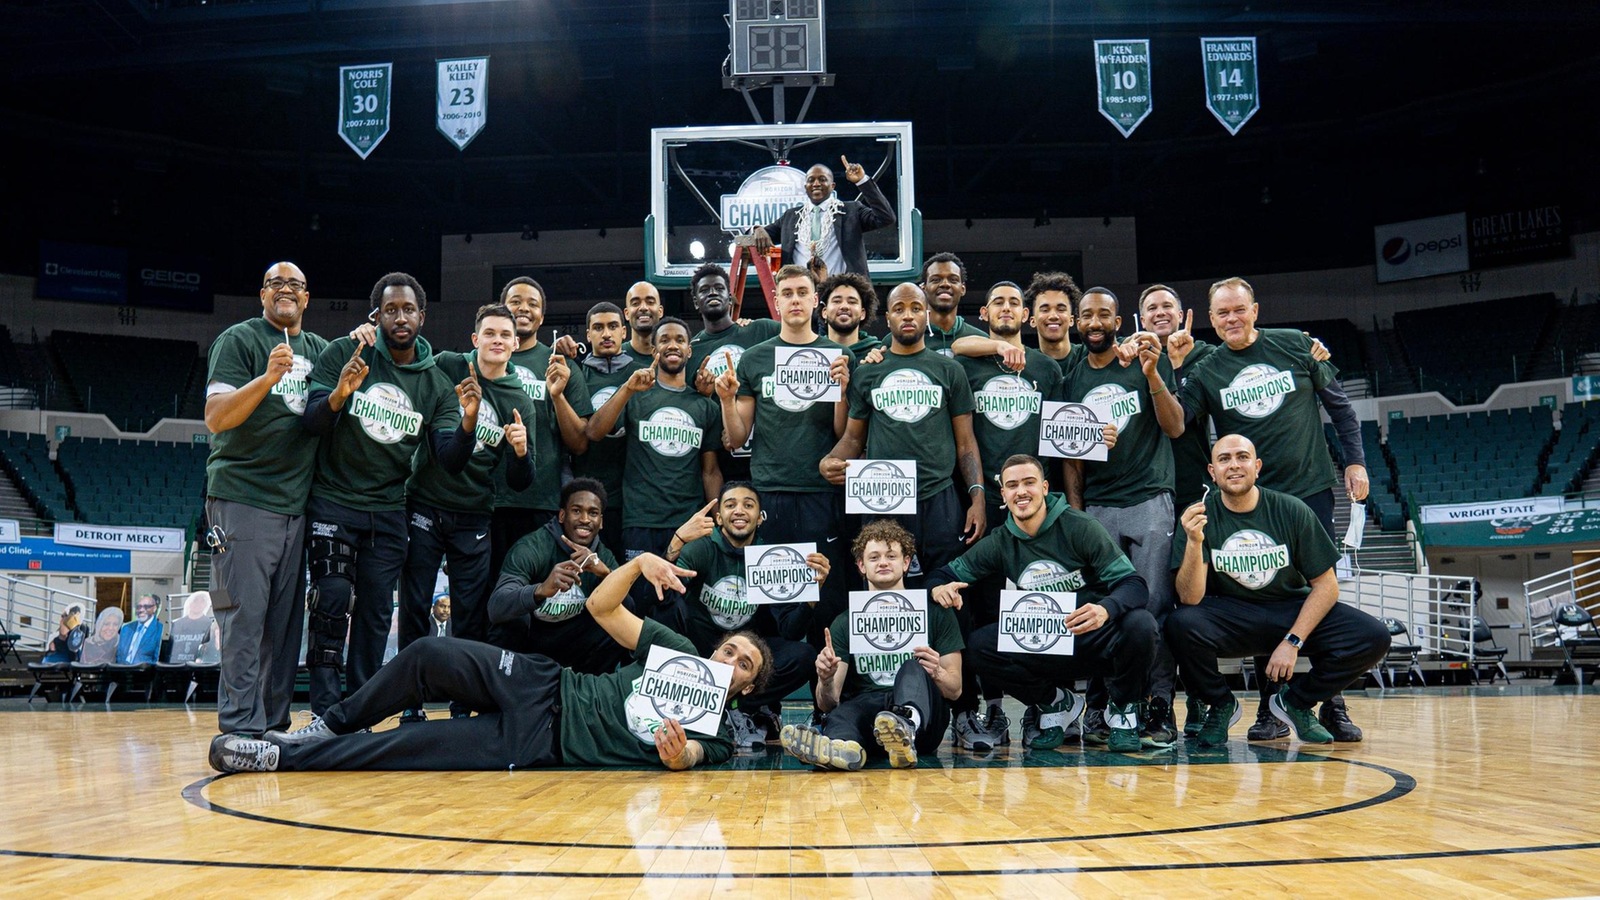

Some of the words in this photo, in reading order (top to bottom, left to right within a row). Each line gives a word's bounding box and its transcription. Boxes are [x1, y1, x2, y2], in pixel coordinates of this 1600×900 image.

[1112, 46, 1132, 54] KEN
[1206, 43, 1250, 52] FRANKLIN
[1207, 52, 1252, 61] EDWARDS
[349, 70, 383, 80] NORRIS
[446, 62, 478, 72] KAILEY
[354, 79, 377, 89] COLE
[450, 72, 475, 81] KLEIN
[1112, 70, 1136, 90] 10
[1218, 68, 1243, 87] 14
[352, 94, 378, 114] 30
[450, 87, 475, 106] 23
[1213, 93, 1253, 101] 1977-1981
[346, 119, 384, 128] 2007-2011
[442, 112, 481, 120] 2006-2010
[1472, 212, 1514, 238] GREAT
[1518, 206, 1561, 231] LAKES
[1415, 234, 1462, 256] pepsi
[141, 268, 200, 284] GEICO
[330, 301, 348, 311] 212
[875, 390, 938, 409] CHAMPIONS
[1225, 376, 1291, 408] CHAMPIONS
[978, 396, 1038, 412] CHAMPIONS
[354, 398, 418, 433] CHAMPIONS
[643, 426, 700, 446] CHAMPIONS
[1046, 425, 1104, 441] CHAMPIONS
[852, 482, 911, 496] CHAMPIONS
[1449, 508, 1497, 519] WRIGHT
[1500, 505, 1536, 514] STATE
[76, 530, 122, 542] DETROIT
[126, 535, 165, 544] MERCY
[1547, 526, 1574, 534] $6
[8, 546, 32, 555] Clinic
[1216, 550, 1285, 572] CHAMPIONS
[752, 568, 812, 585] CHAMPIONS
[857, 616, 921, 633] CHAMPIONS
[1005, 617, 1068, 634] CHAMPIONS
[645, 677, 719, 711] CHAMPIONS
